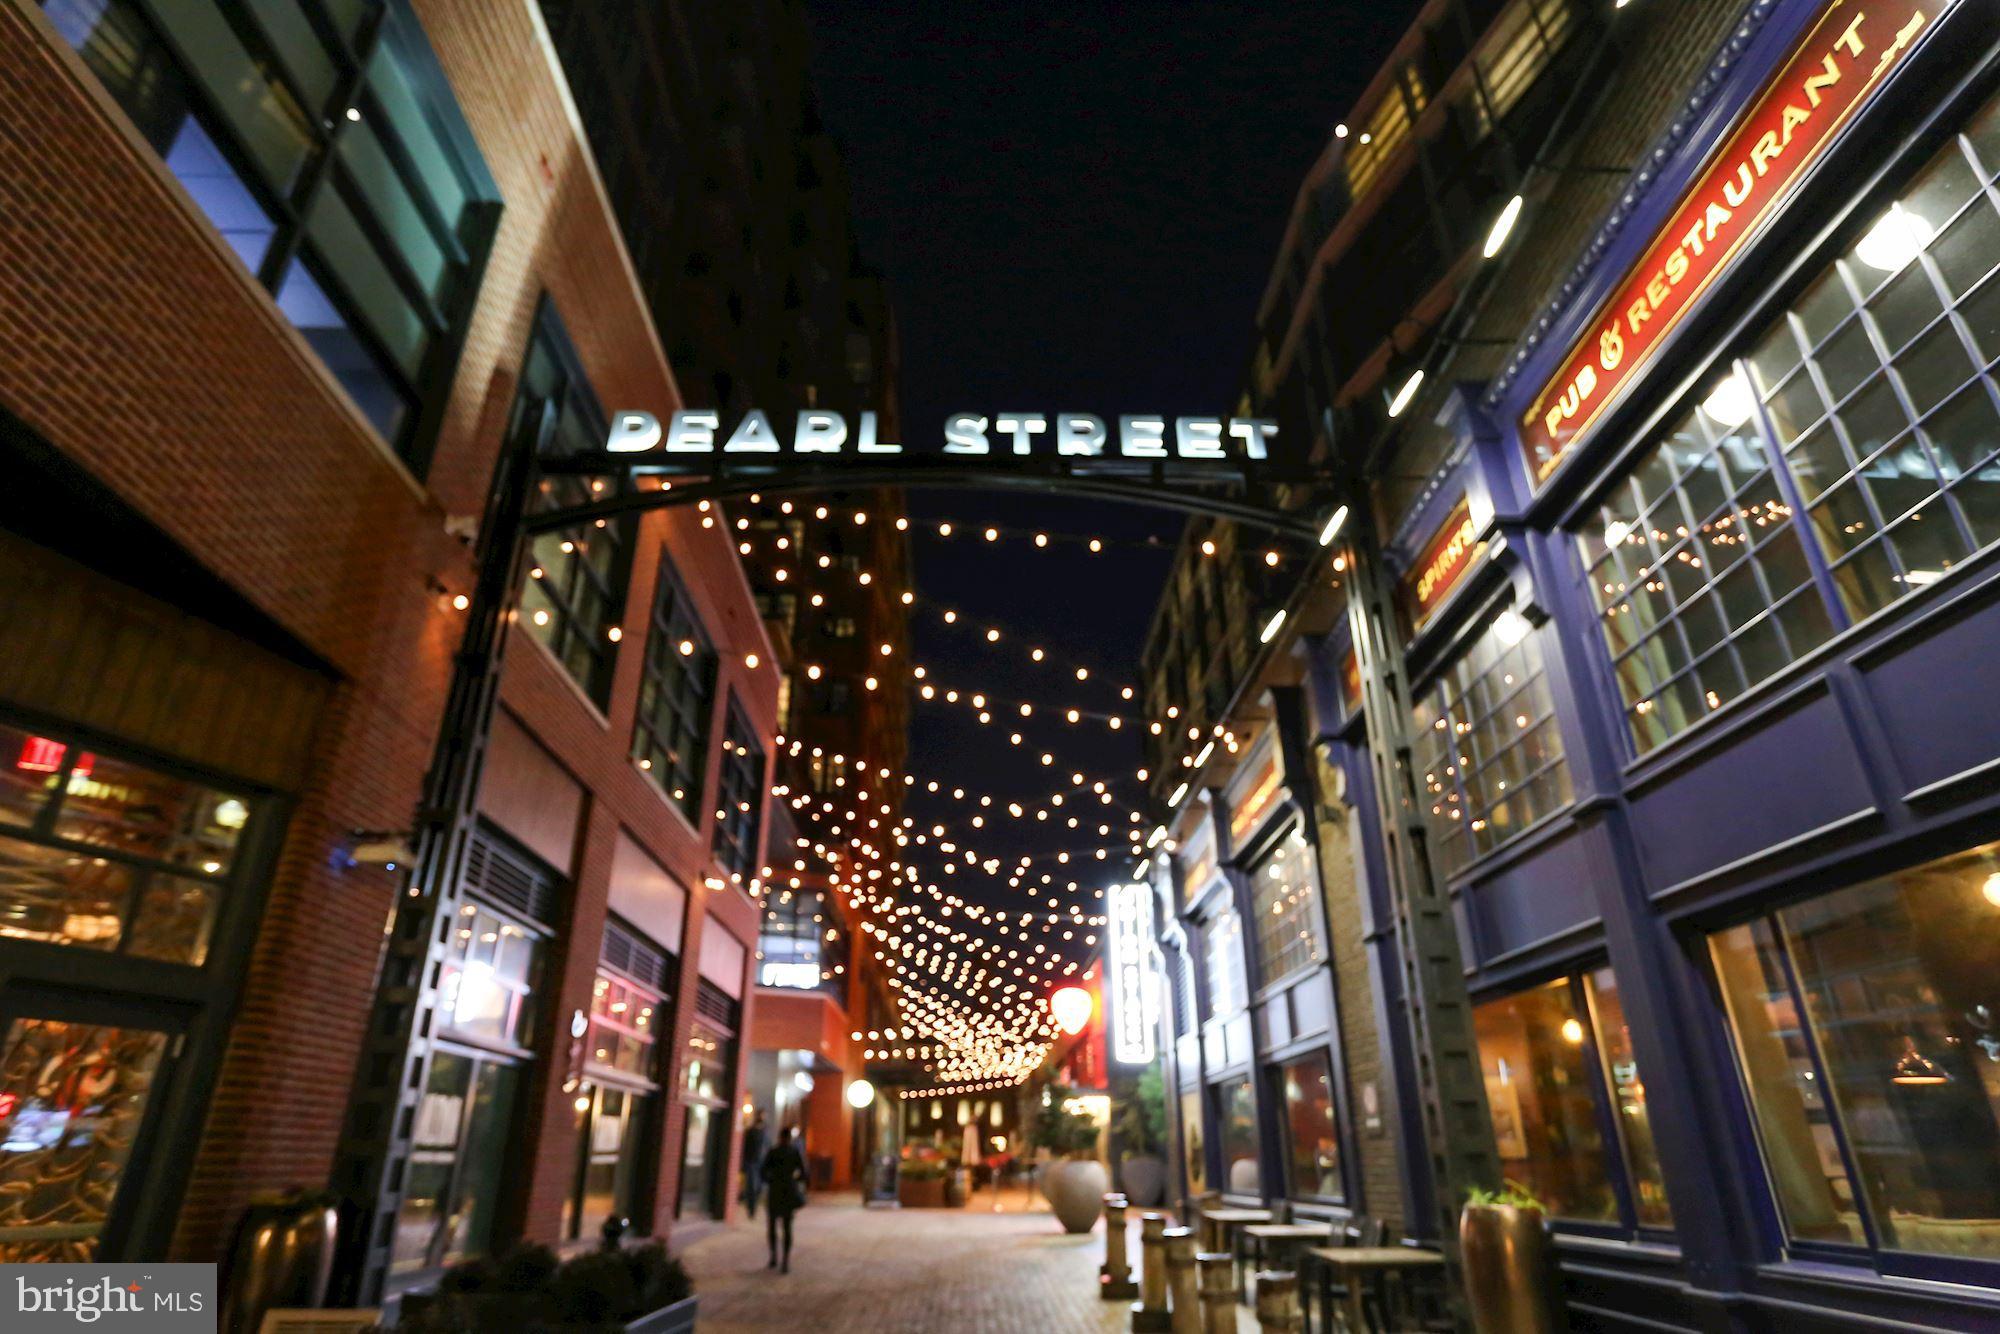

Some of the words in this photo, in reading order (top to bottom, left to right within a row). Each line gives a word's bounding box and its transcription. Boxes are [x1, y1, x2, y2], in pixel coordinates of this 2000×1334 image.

[1545, 365, 1597, 437] PUB
[1600, 318, 1625, 370] &
[1627, 12, 1866, 334] RESTAURANT
[606, 409, 903, 454] PEARL
[943, 410, 1280, 460] STREET
